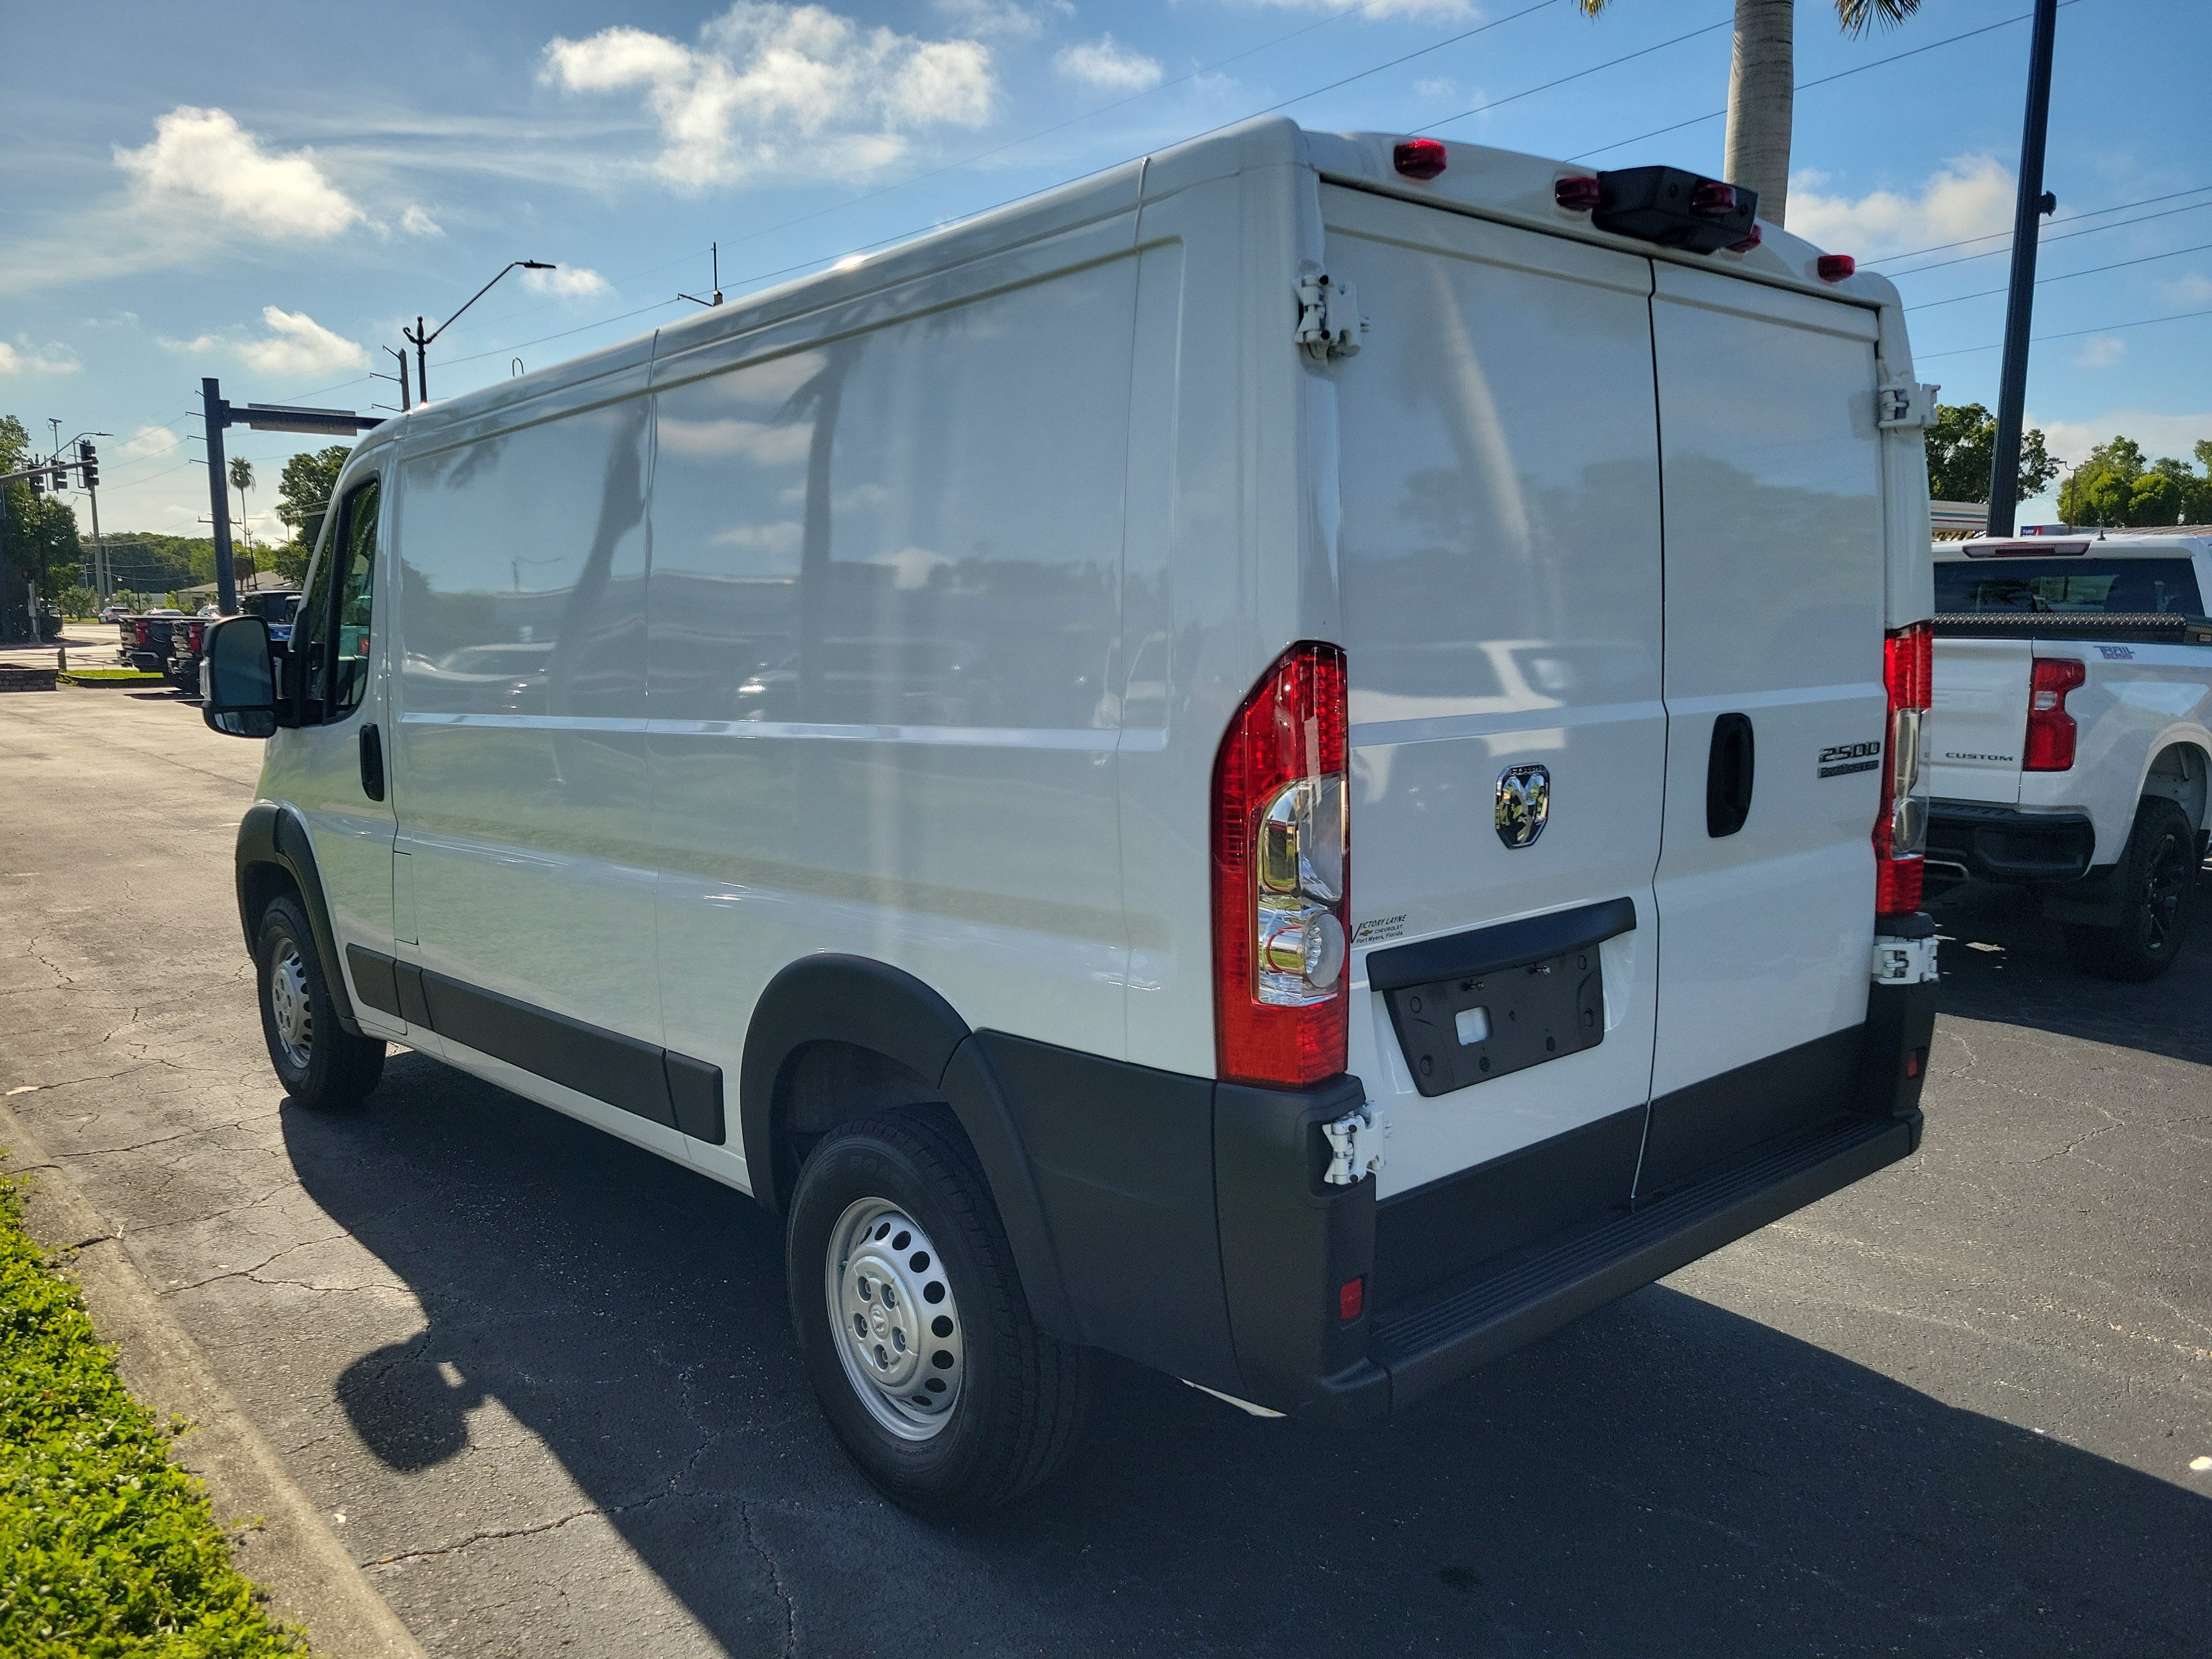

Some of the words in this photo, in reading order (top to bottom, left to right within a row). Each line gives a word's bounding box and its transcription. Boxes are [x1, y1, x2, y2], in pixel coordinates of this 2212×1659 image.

[2093, 646, 2136, 656] TRAIL
[1819, 741, 1880, 763] 2500
[1945, 752, 2013, 761] CUSTOM
[1350, 918, 1385, 944] VICTORY
[1386, 914, 1407, 924] LAYNE
[1374, 924, 1403, 934] CHEVROLET
